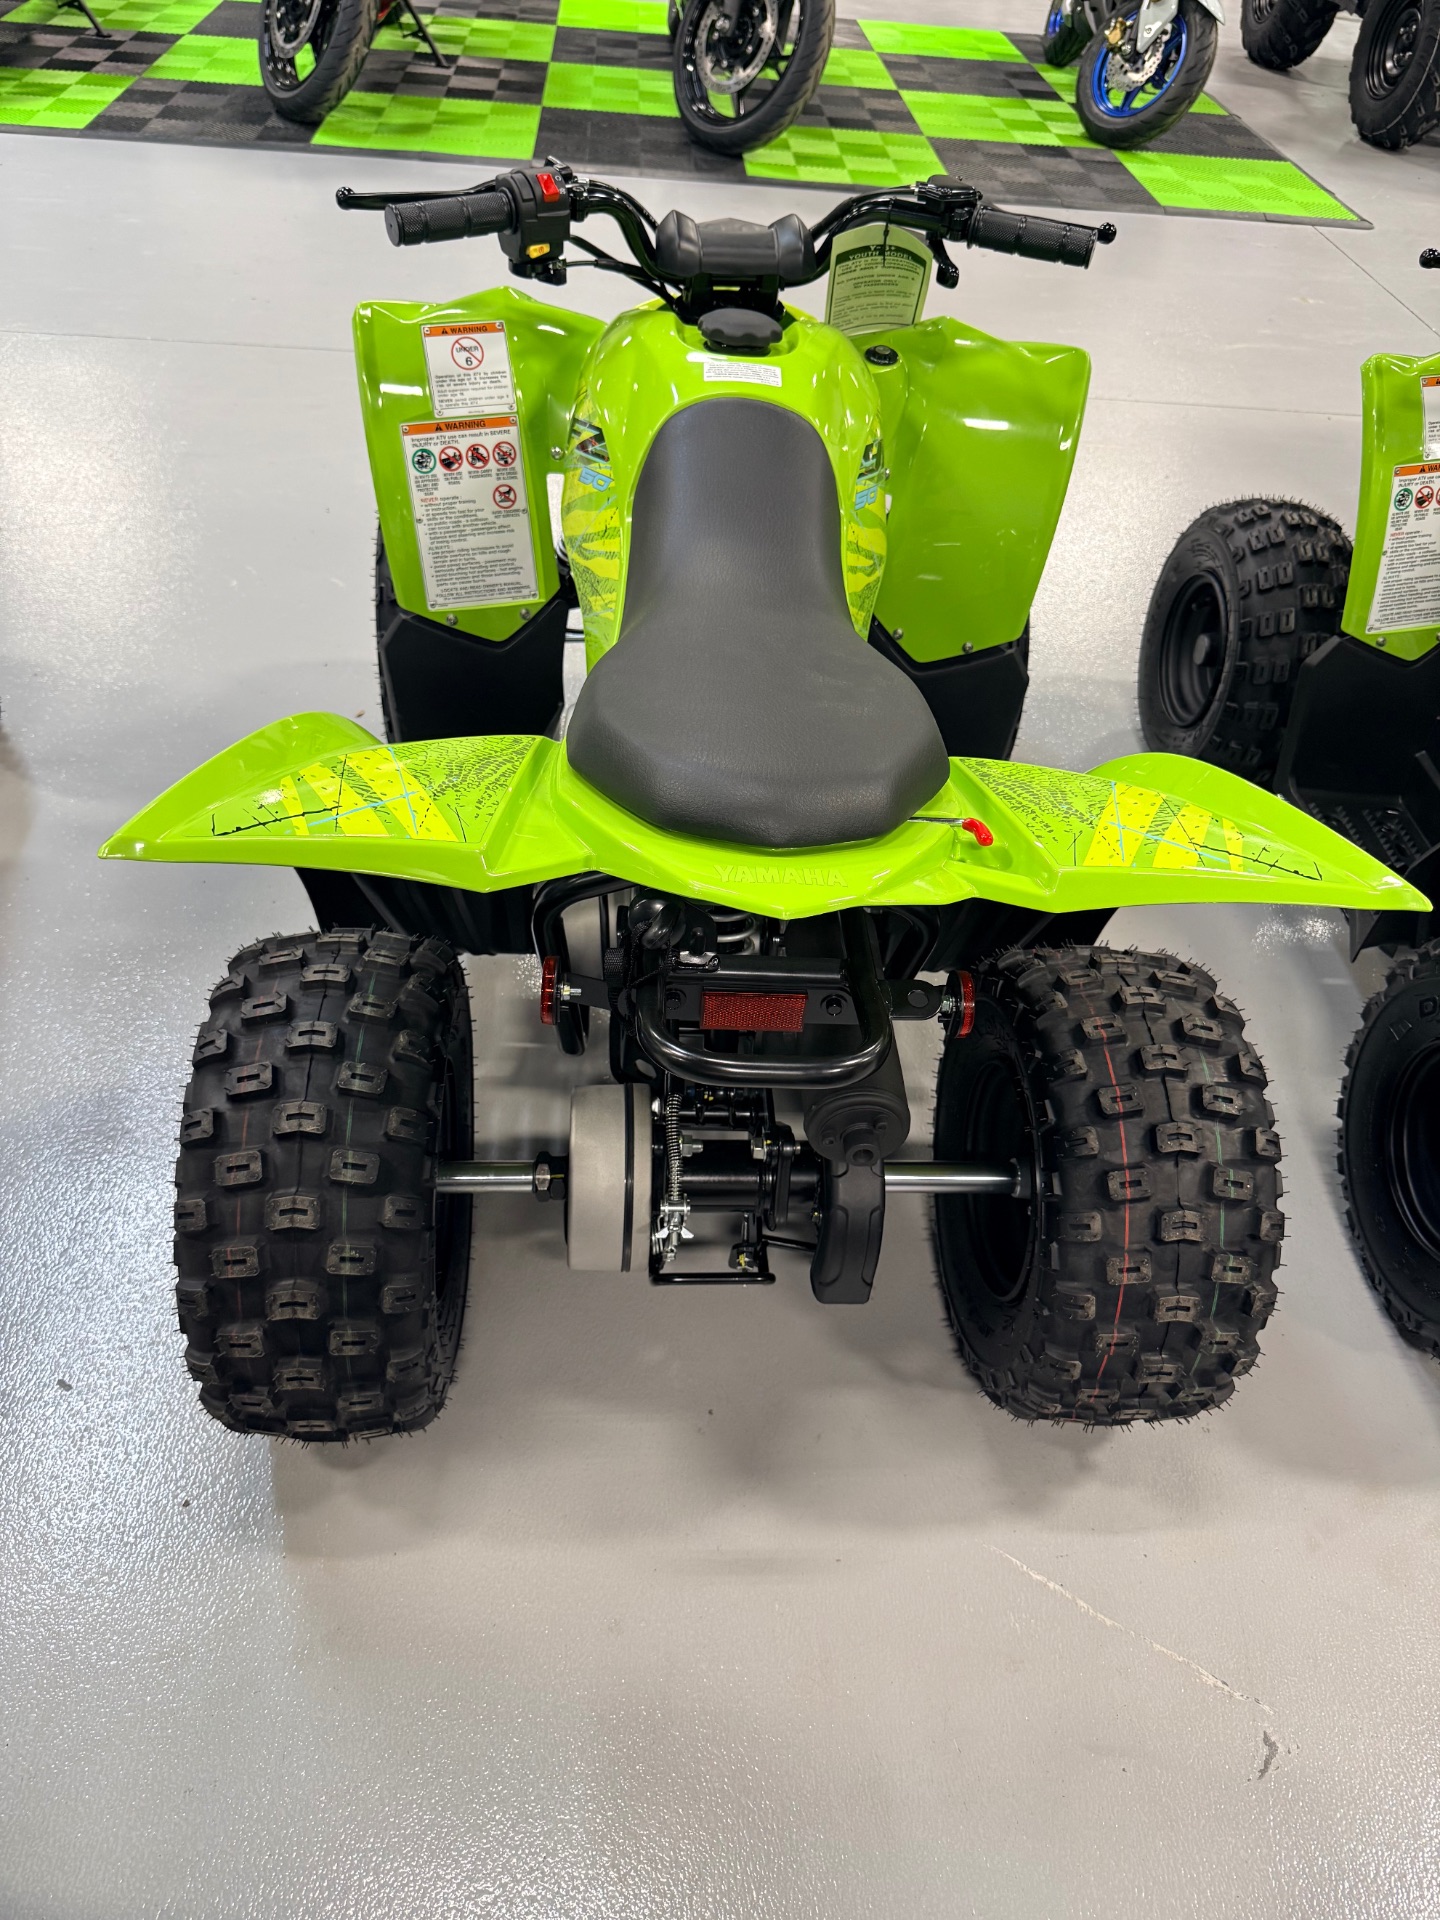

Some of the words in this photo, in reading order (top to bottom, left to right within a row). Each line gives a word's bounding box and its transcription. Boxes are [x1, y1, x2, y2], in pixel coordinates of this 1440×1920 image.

[849, 252, 879, 260] YOUTH
[450, 326, 488, 334] WARNING
[466, 357, 472, 366] 6
[445, 420, 486, 431] WARNING
[578, 466, 614, 492] 50
[714, 864, 848, 887] YAMAHA
